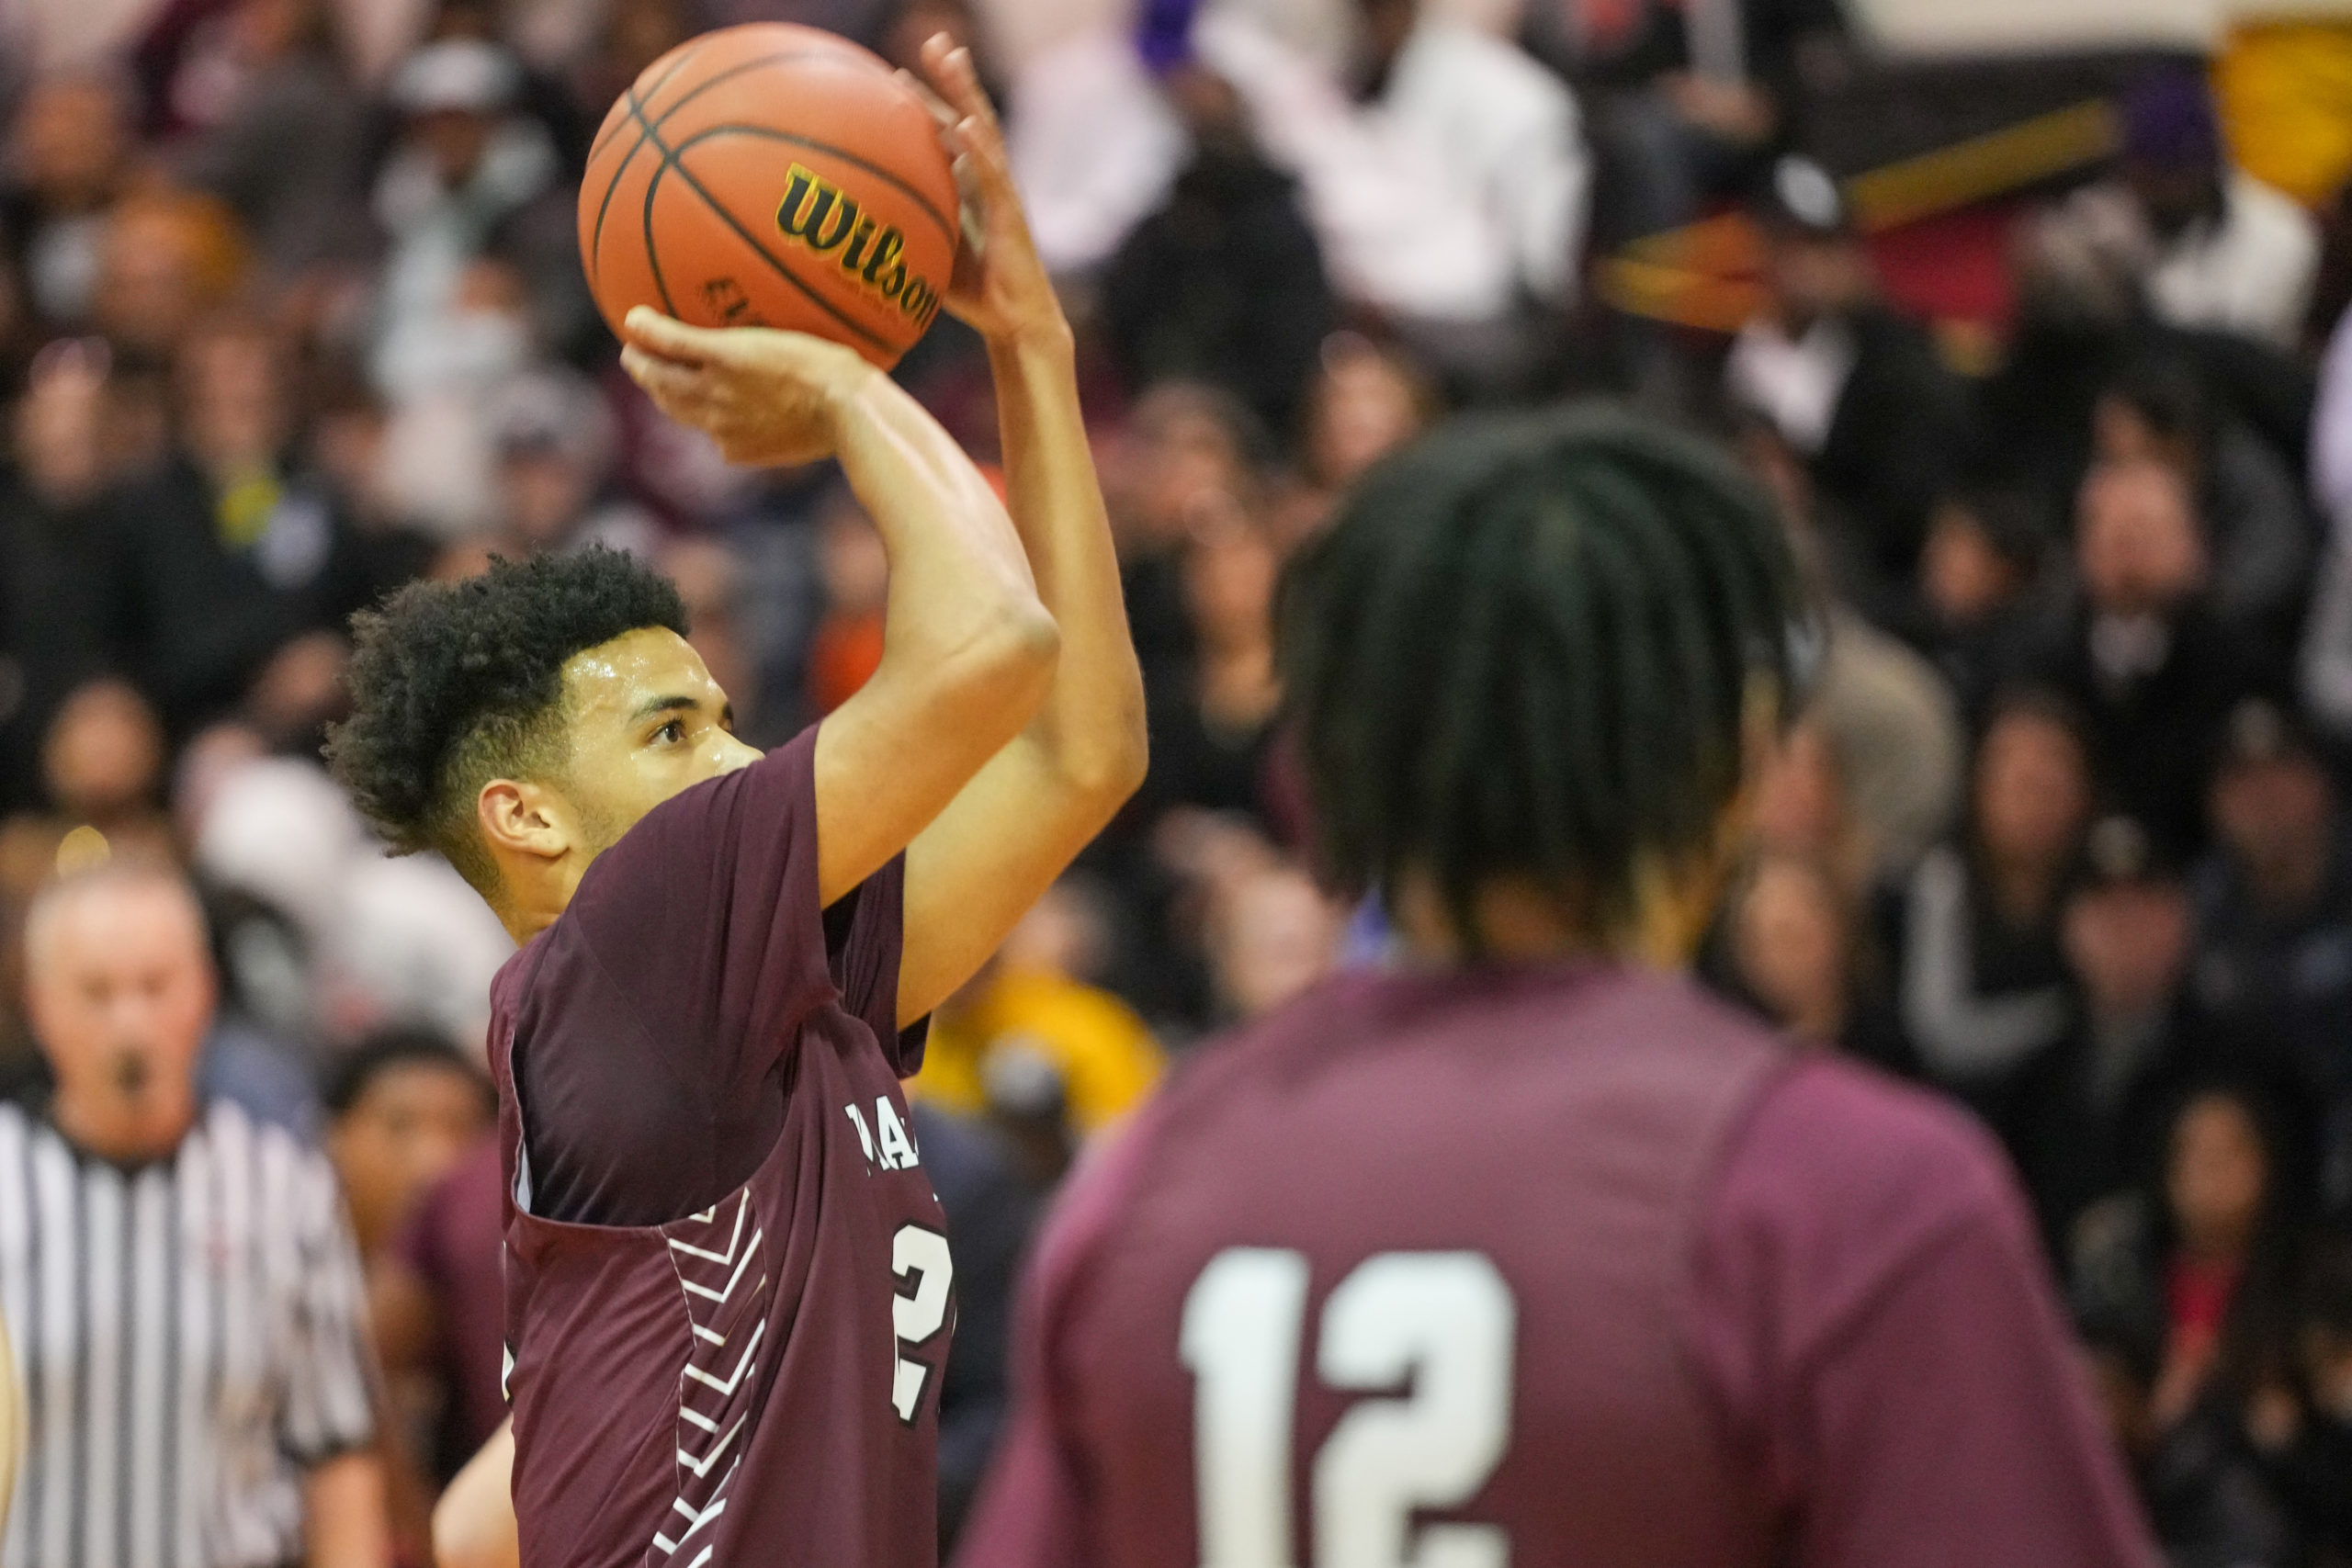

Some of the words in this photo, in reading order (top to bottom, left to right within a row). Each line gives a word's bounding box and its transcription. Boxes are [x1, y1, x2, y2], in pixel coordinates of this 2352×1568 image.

[775, 162, 938, 328] Wilson
[891, 1224, 956, 1422] 2
[1178, 1246, 1518, 1568] 12
